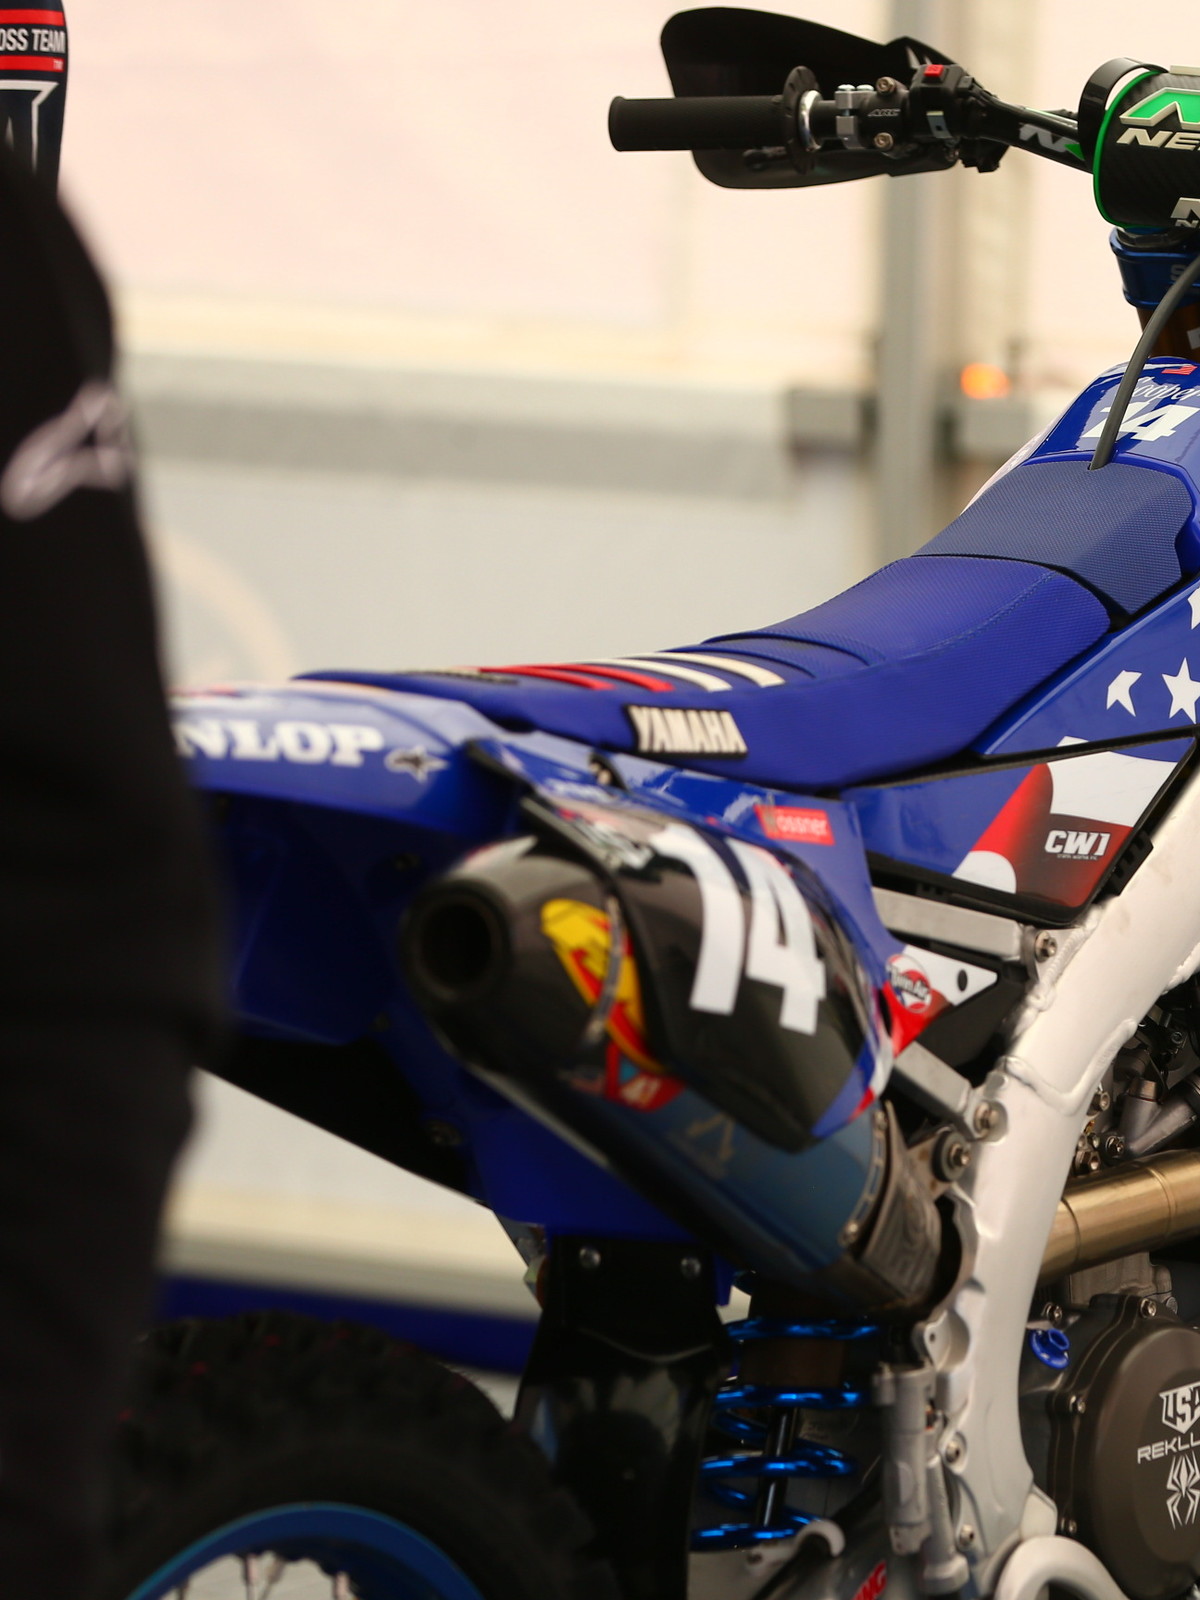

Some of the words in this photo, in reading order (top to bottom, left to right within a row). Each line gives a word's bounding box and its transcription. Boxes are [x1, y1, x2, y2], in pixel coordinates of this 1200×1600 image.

[0, 28, 29, 51] OSS
[31, 28, 66, 54] TEAM
[172, 718, 385, 768] NLOP
[628, 704, 748, 753] YAMAHA
